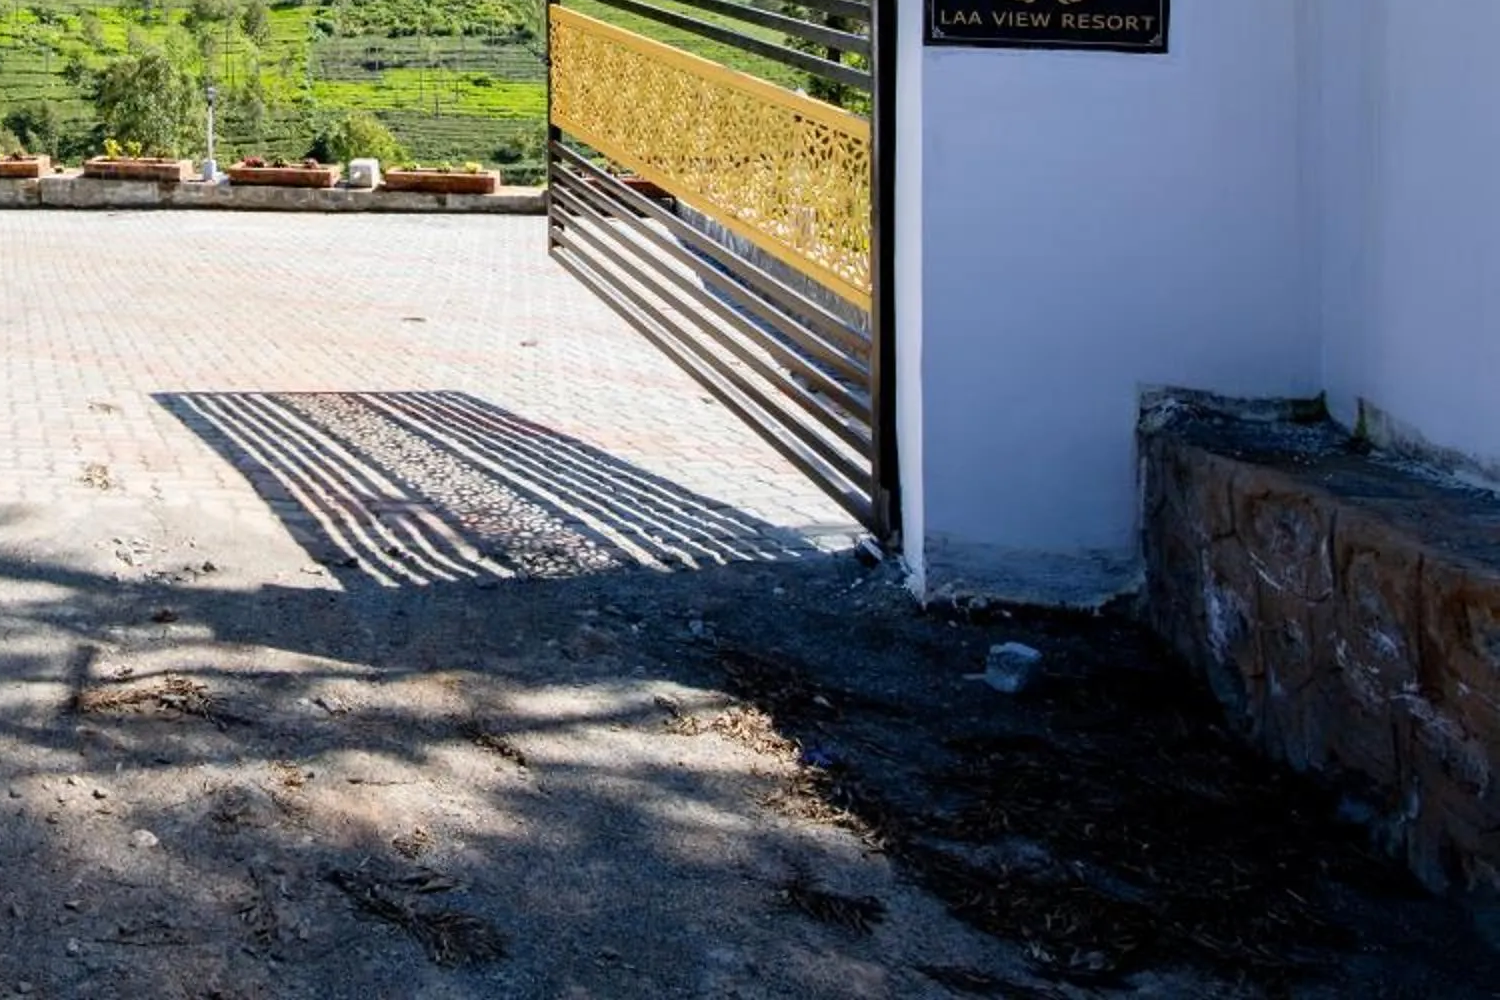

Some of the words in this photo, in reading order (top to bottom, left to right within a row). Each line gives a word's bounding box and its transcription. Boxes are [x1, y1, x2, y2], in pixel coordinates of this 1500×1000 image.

[941, 10, 983, 26] LAA
[991, 11, 1050, 28] VIEW
[1061, 13, 1156, 31] RESORT
